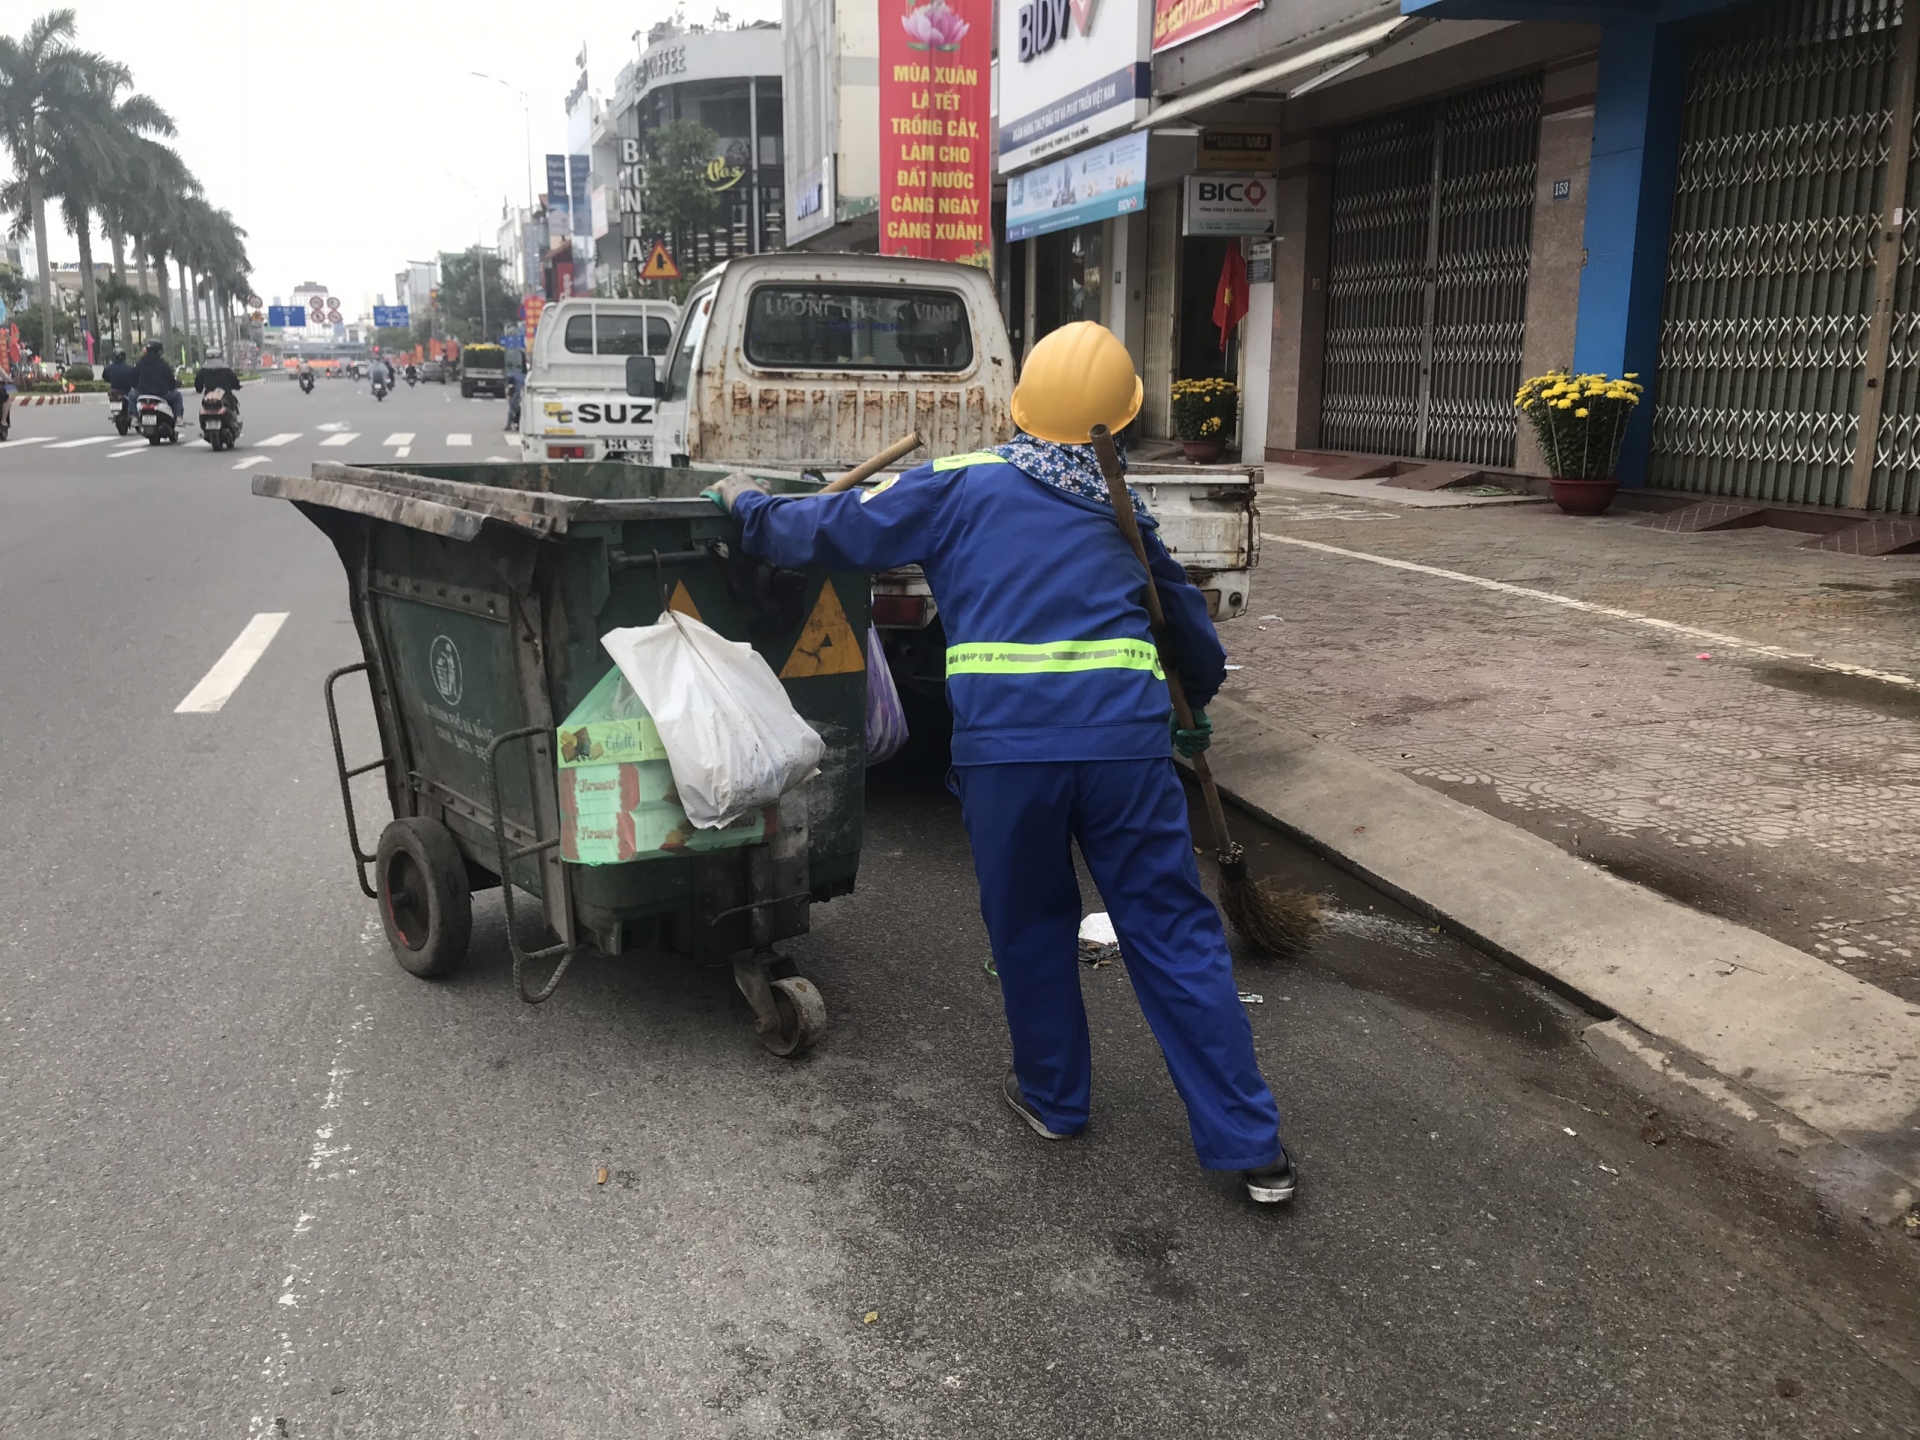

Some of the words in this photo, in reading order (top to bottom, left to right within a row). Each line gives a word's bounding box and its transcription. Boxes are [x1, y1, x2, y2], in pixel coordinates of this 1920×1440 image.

[1018, 0, 1068, 63] BIDV
[893, 62, 930, 83] MÙA
[934, 64, 977, 86] XUÂN
[911, 89, 930, 109] LÀ
[934, 89, 961, 110] TẾT
[946, 117, 979, 140] CÂY,
[901, 141, 935, 161] LÀM
[939, 146, 970, 163] CHO
[897, 164, 927, 187] ĐẤT
[931, 168, 974, 190] NƯỚC
[1554, 181, 1569, 196] 153
[891, 192, 935, 214] CÀNG
[938, 194, 980, 215] NGÀY
[1199, 183, 1243, 202] BIC
[887, 218, 931, 239] CÀNG
[935, 220, 983, 241] XUÂN!
